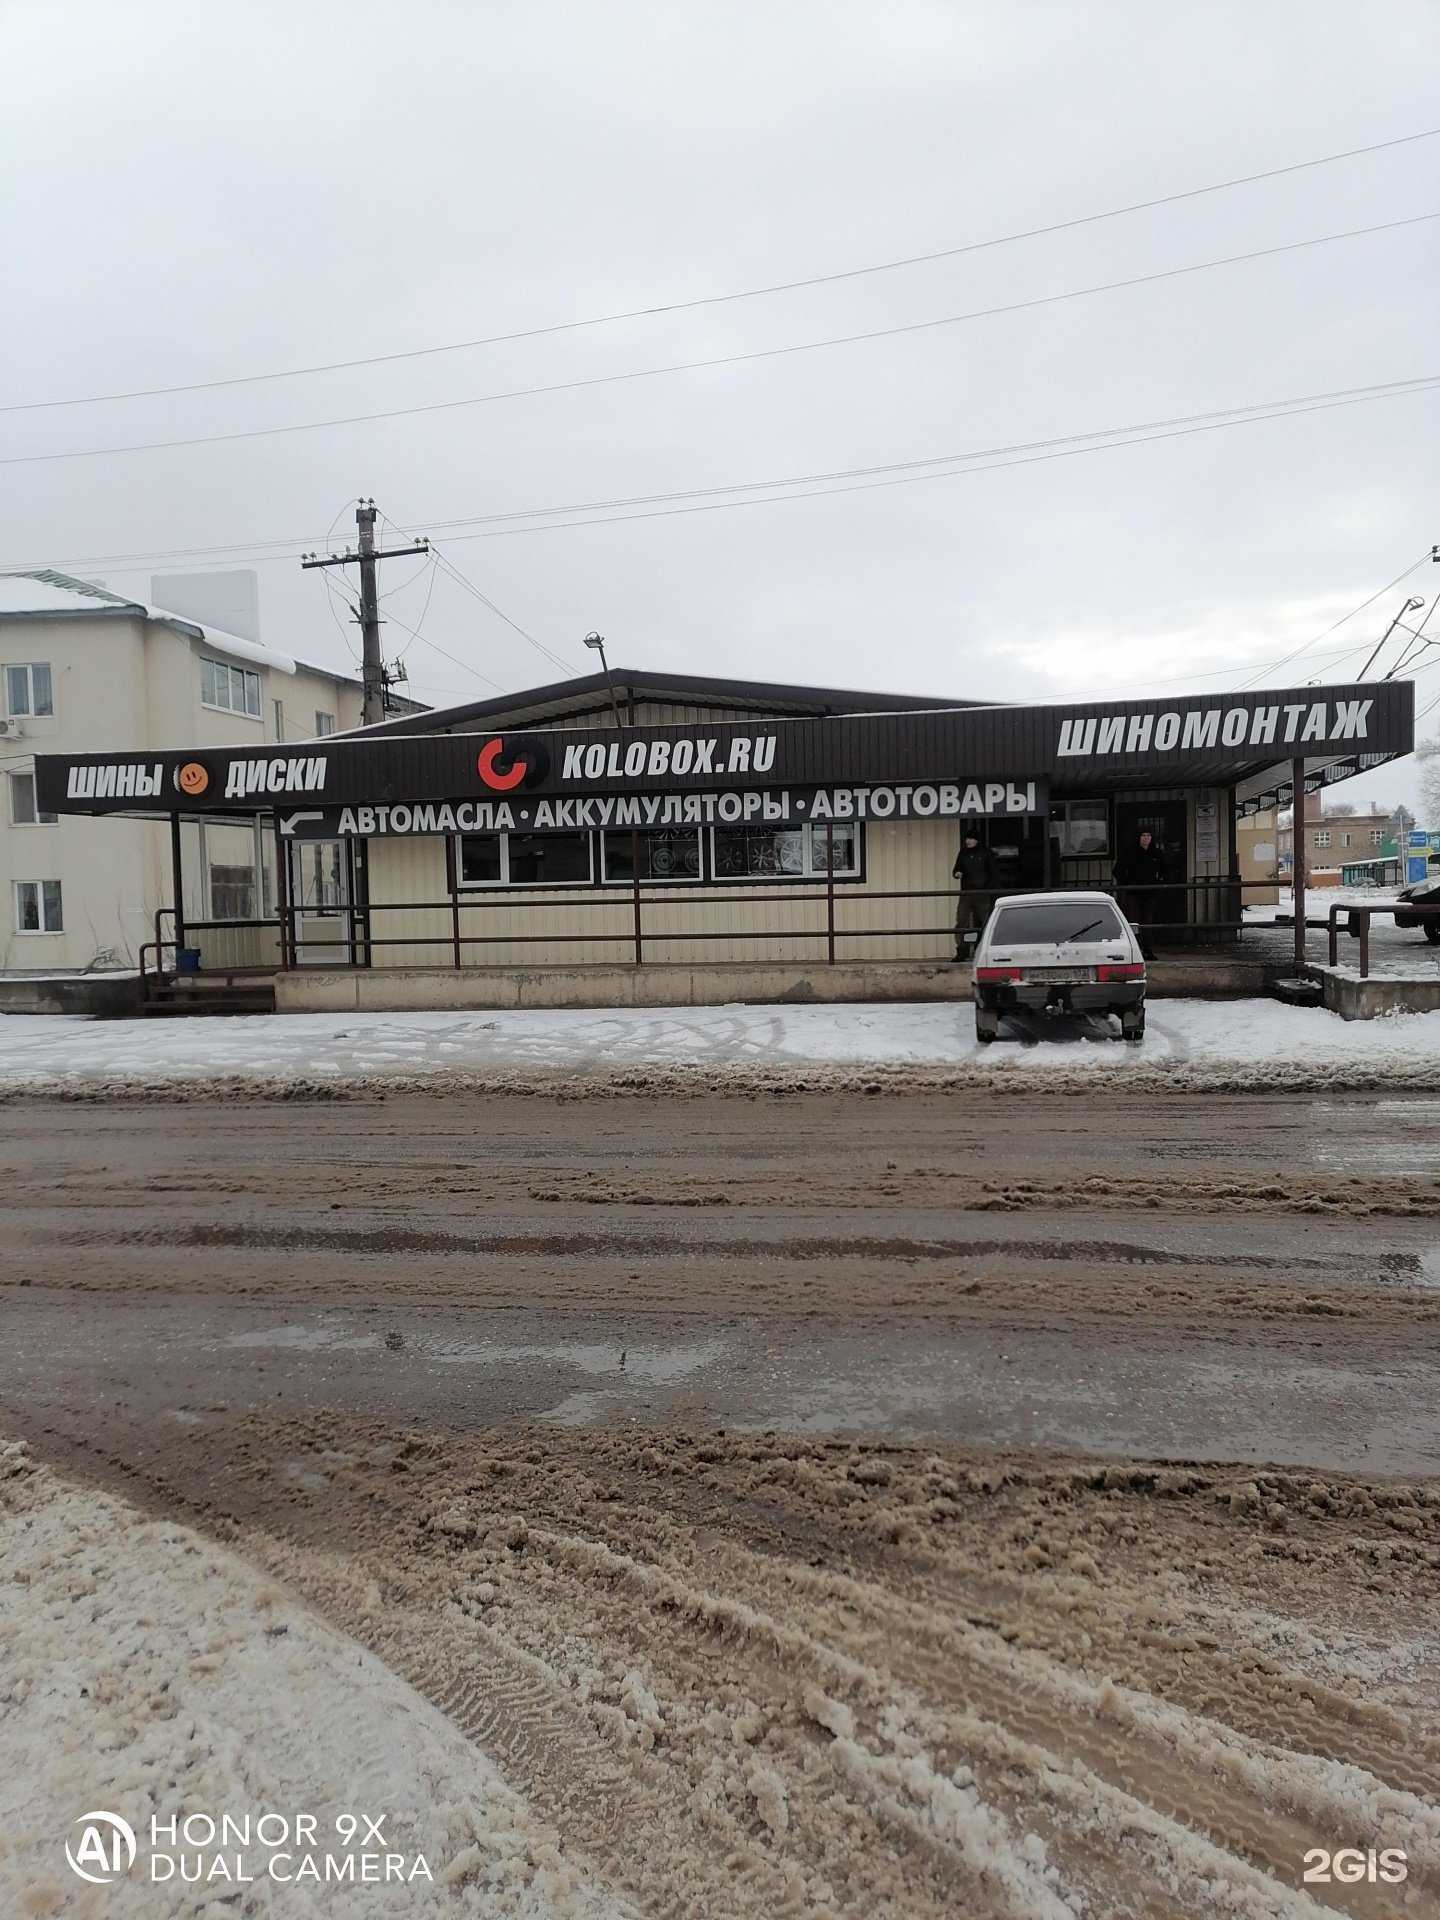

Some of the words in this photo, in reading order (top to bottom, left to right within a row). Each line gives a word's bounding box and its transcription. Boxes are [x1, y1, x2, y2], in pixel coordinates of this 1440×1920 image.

[1056, 700, 1375, 757] ШИНОМОНТАЖ
[66, 764, 163, 799] ШИНЫ
[224, 757, 327, 798] ДИСКИ
[561, 736, 777, 779] KOLOBOX.RU
[337, 802, 516, 834] АВТОМАСЛА
[533, 791, 790, 828] АККУМУЛЯТОРЫ
[809, 782, 1036, 818] АВТОТОВАРЫ
